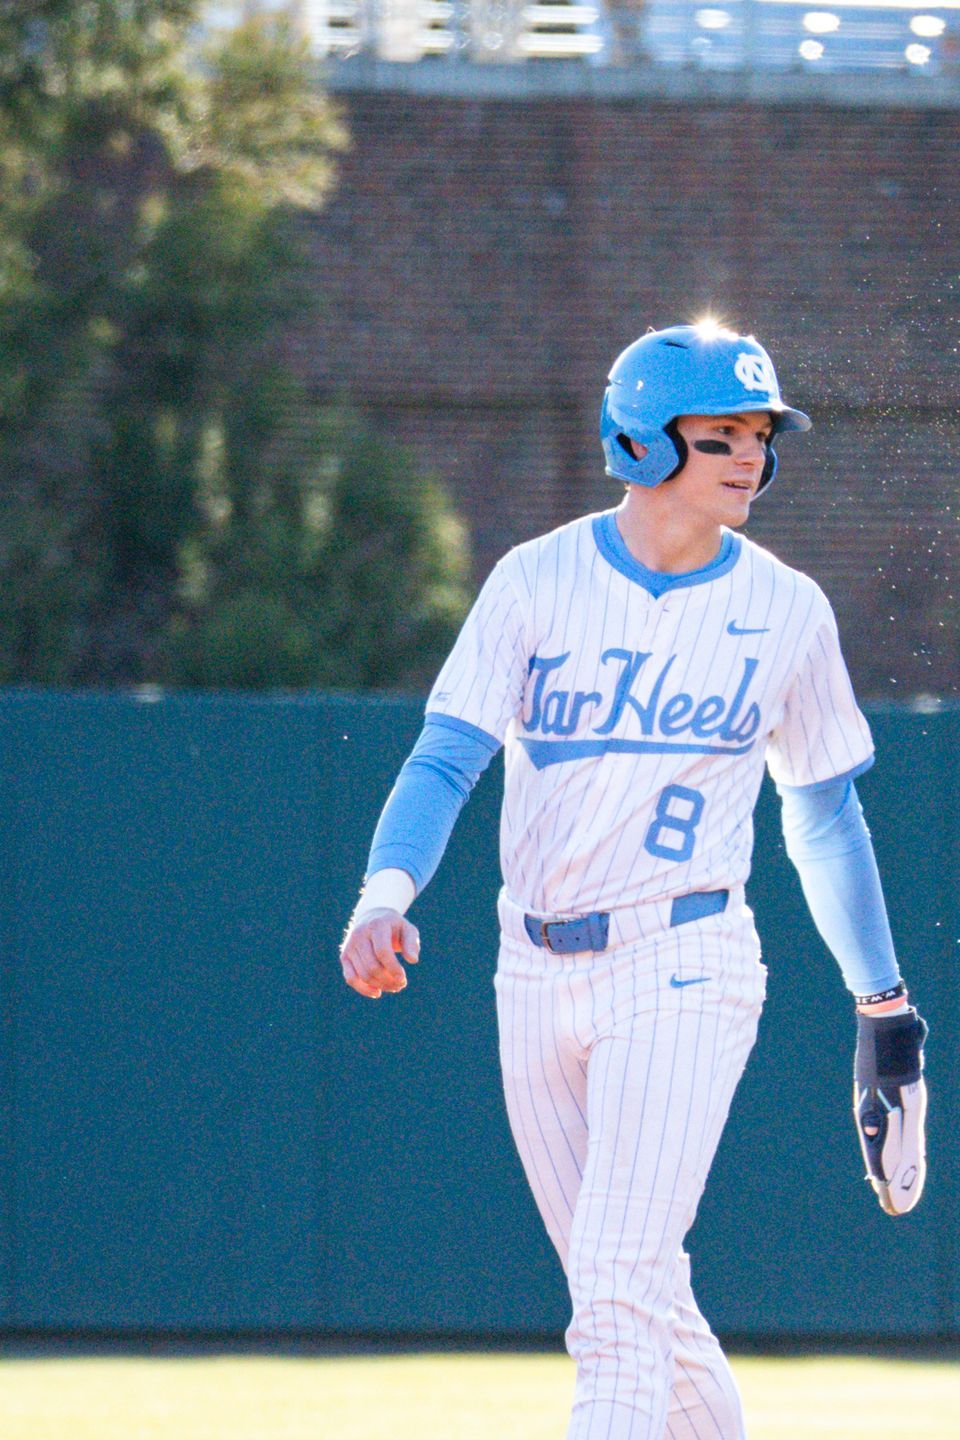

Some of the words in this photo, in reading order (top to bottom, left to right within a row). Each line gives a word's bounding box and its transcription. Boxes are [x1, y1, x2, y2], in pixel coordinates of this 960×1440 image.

[522, 651, 603, 735] Tar
[592, 647, 761, 743] Heels
[643, 783, 706, 863] 8
